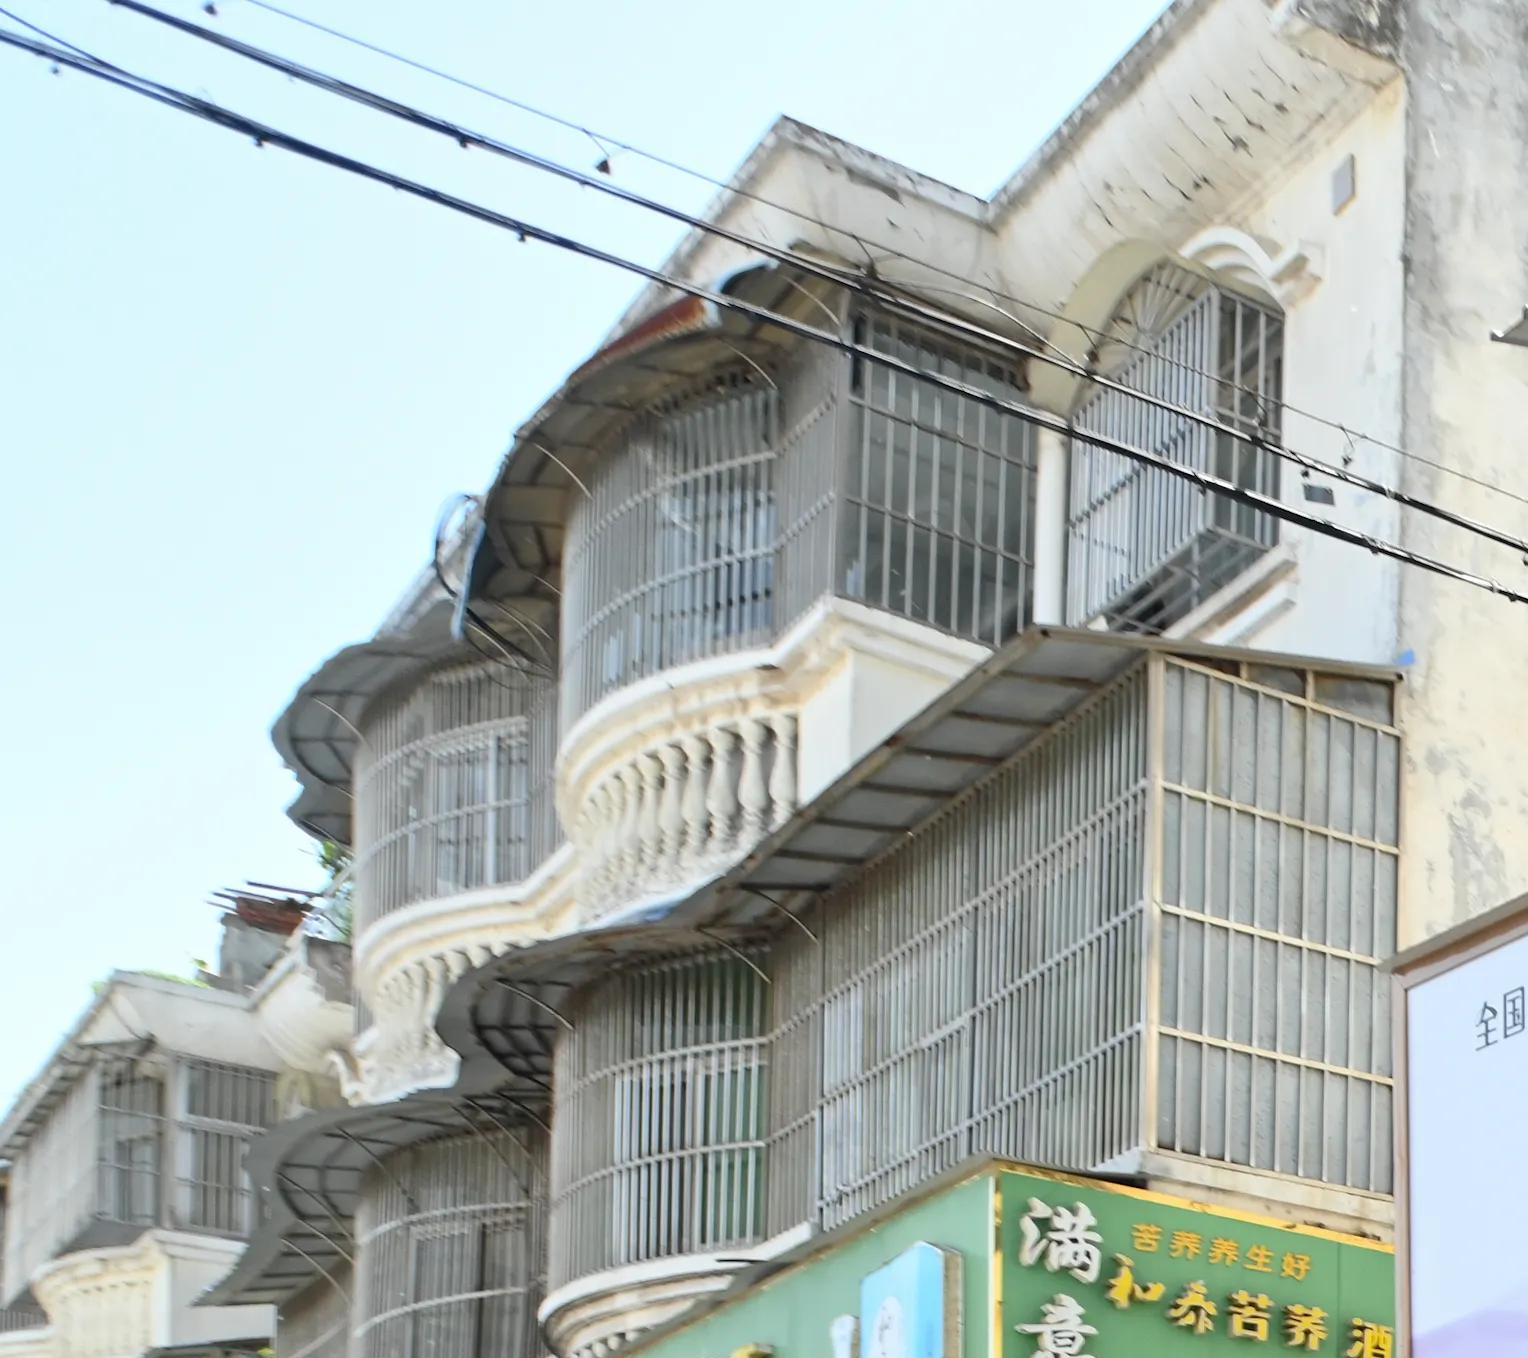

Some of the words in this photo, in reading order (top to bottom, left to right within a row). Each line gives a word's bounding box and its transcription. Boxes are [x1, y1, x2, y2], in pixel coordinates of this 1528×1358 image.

[1132, 1223, 1313, 1281] 苦荞养生好
